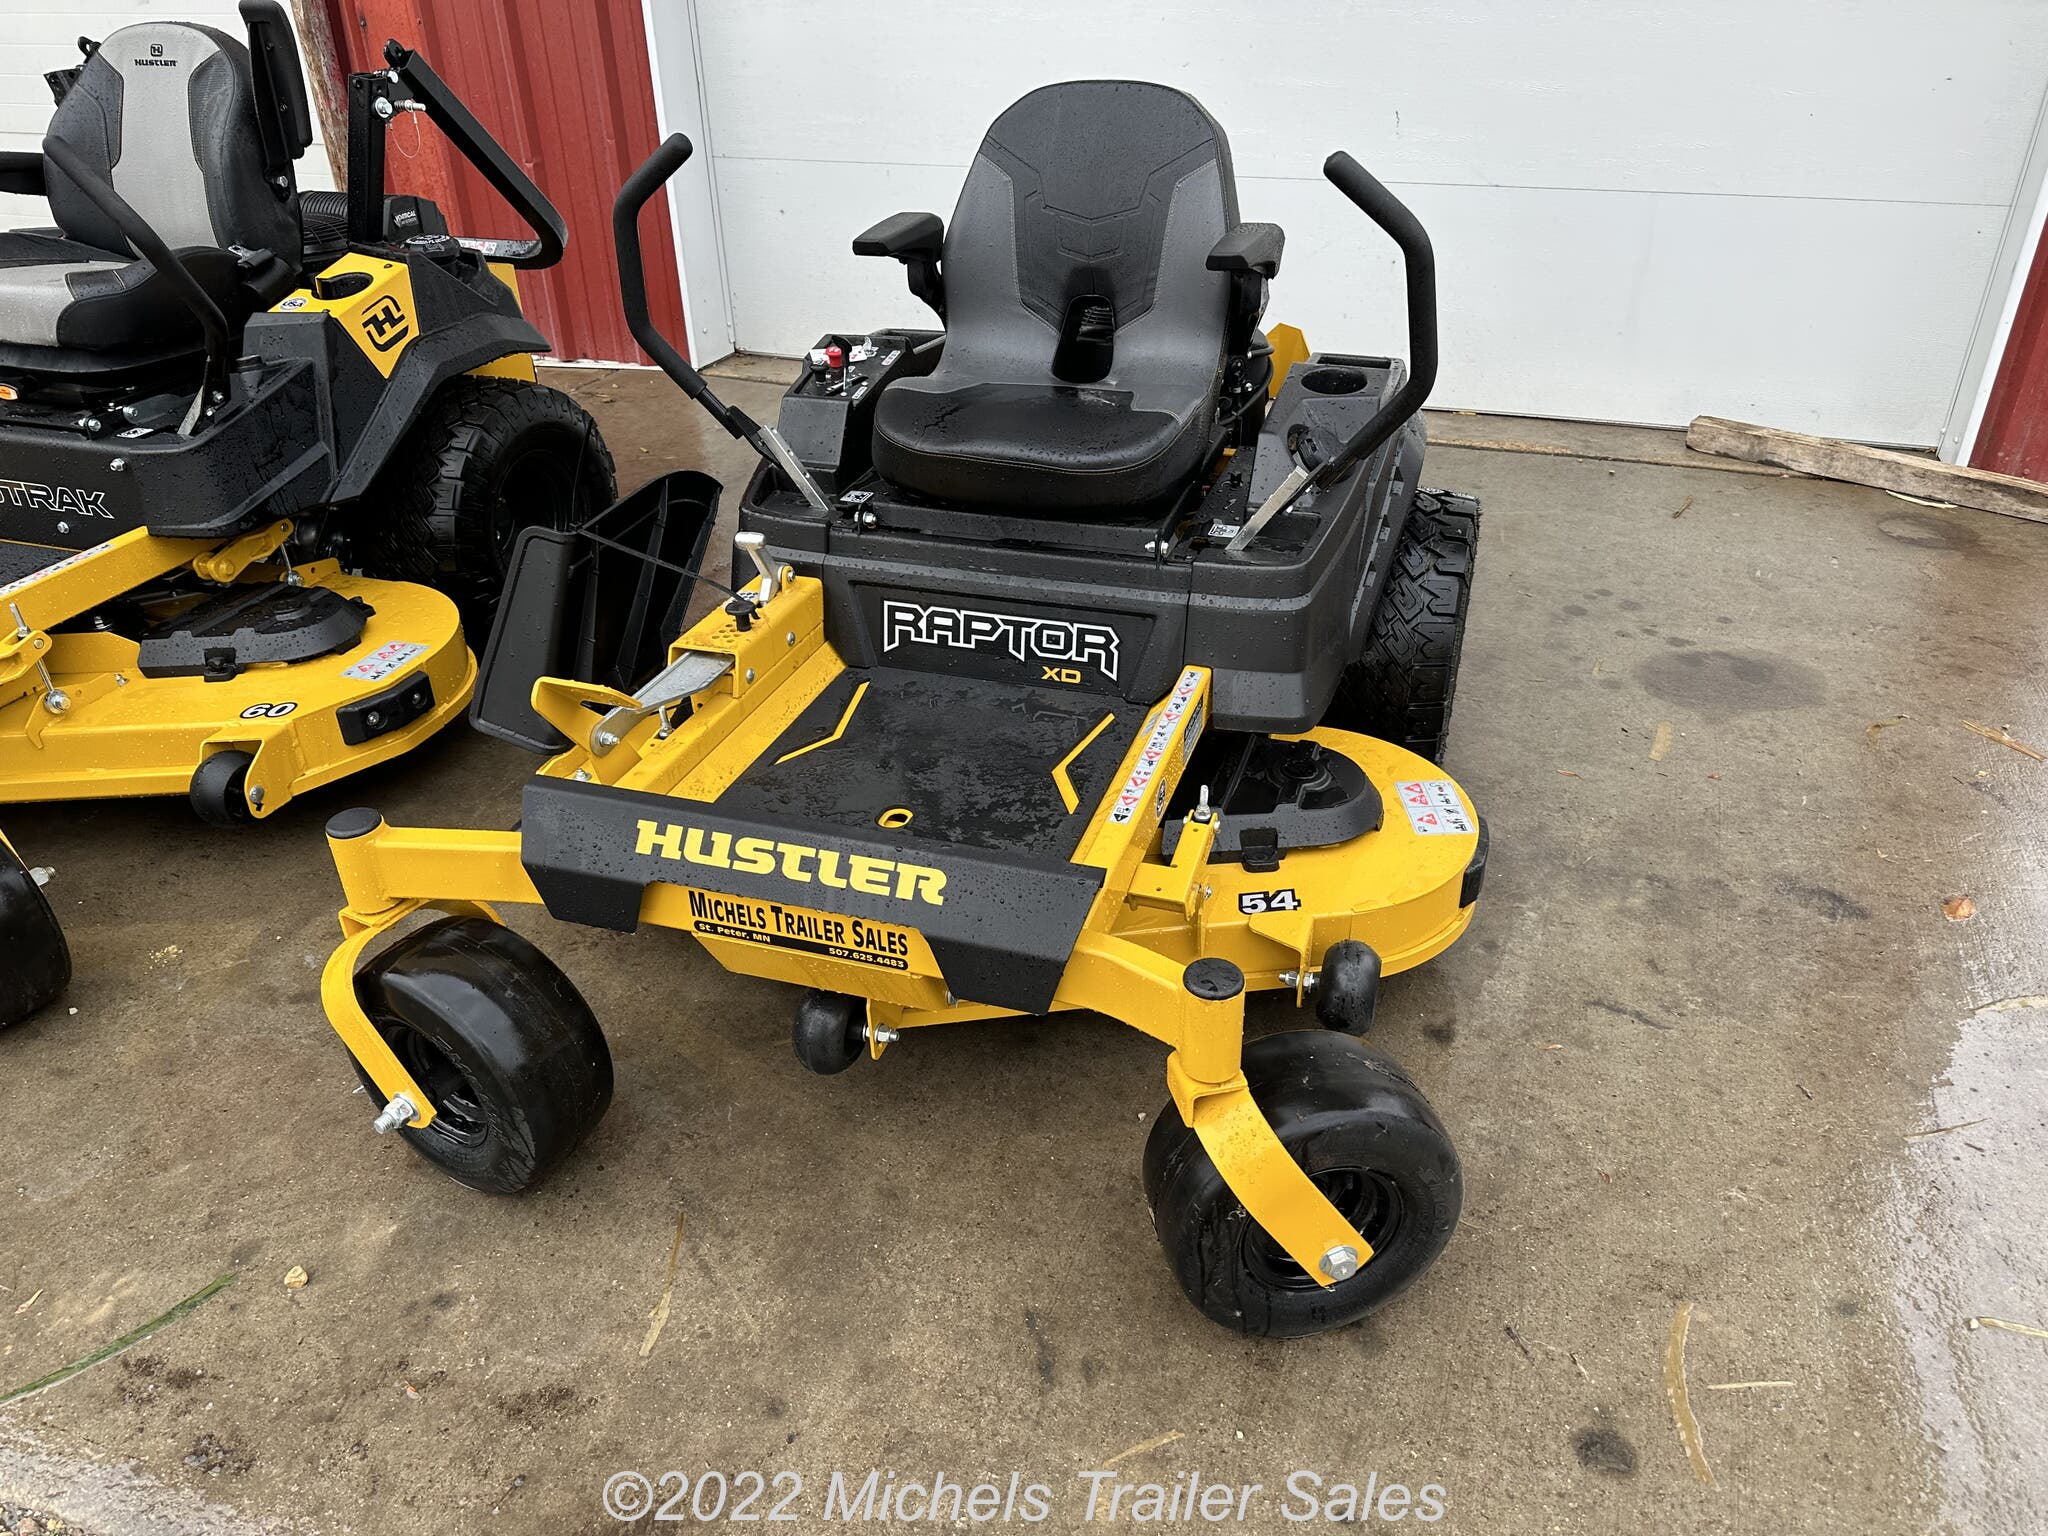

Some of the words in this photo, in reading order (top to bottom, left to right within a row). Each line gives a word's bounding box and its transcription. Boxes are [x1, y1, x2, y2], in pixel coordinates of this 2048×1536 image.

[134, 59, 177, 67] HUSTLER
[0, 479, 115, 519] TRAK
[884, 600, 1120, 681] RAPTOR
[1041, 666, 1082, 684] XD
[240, 702, 298, 719] 60
[635, 819, 947, 905] HUSTLER
[1240, 889, 1301, 915] 54
[688, 891, 767, 930] MICHELS
[771, 906, 846, 945] TRAILER
[852, 920, 908, 956] SALES
[698, 923, 714, 932] St.
[753, 933, 771, 943] MN
[829, 947, 905, 968] 507.625.4483
